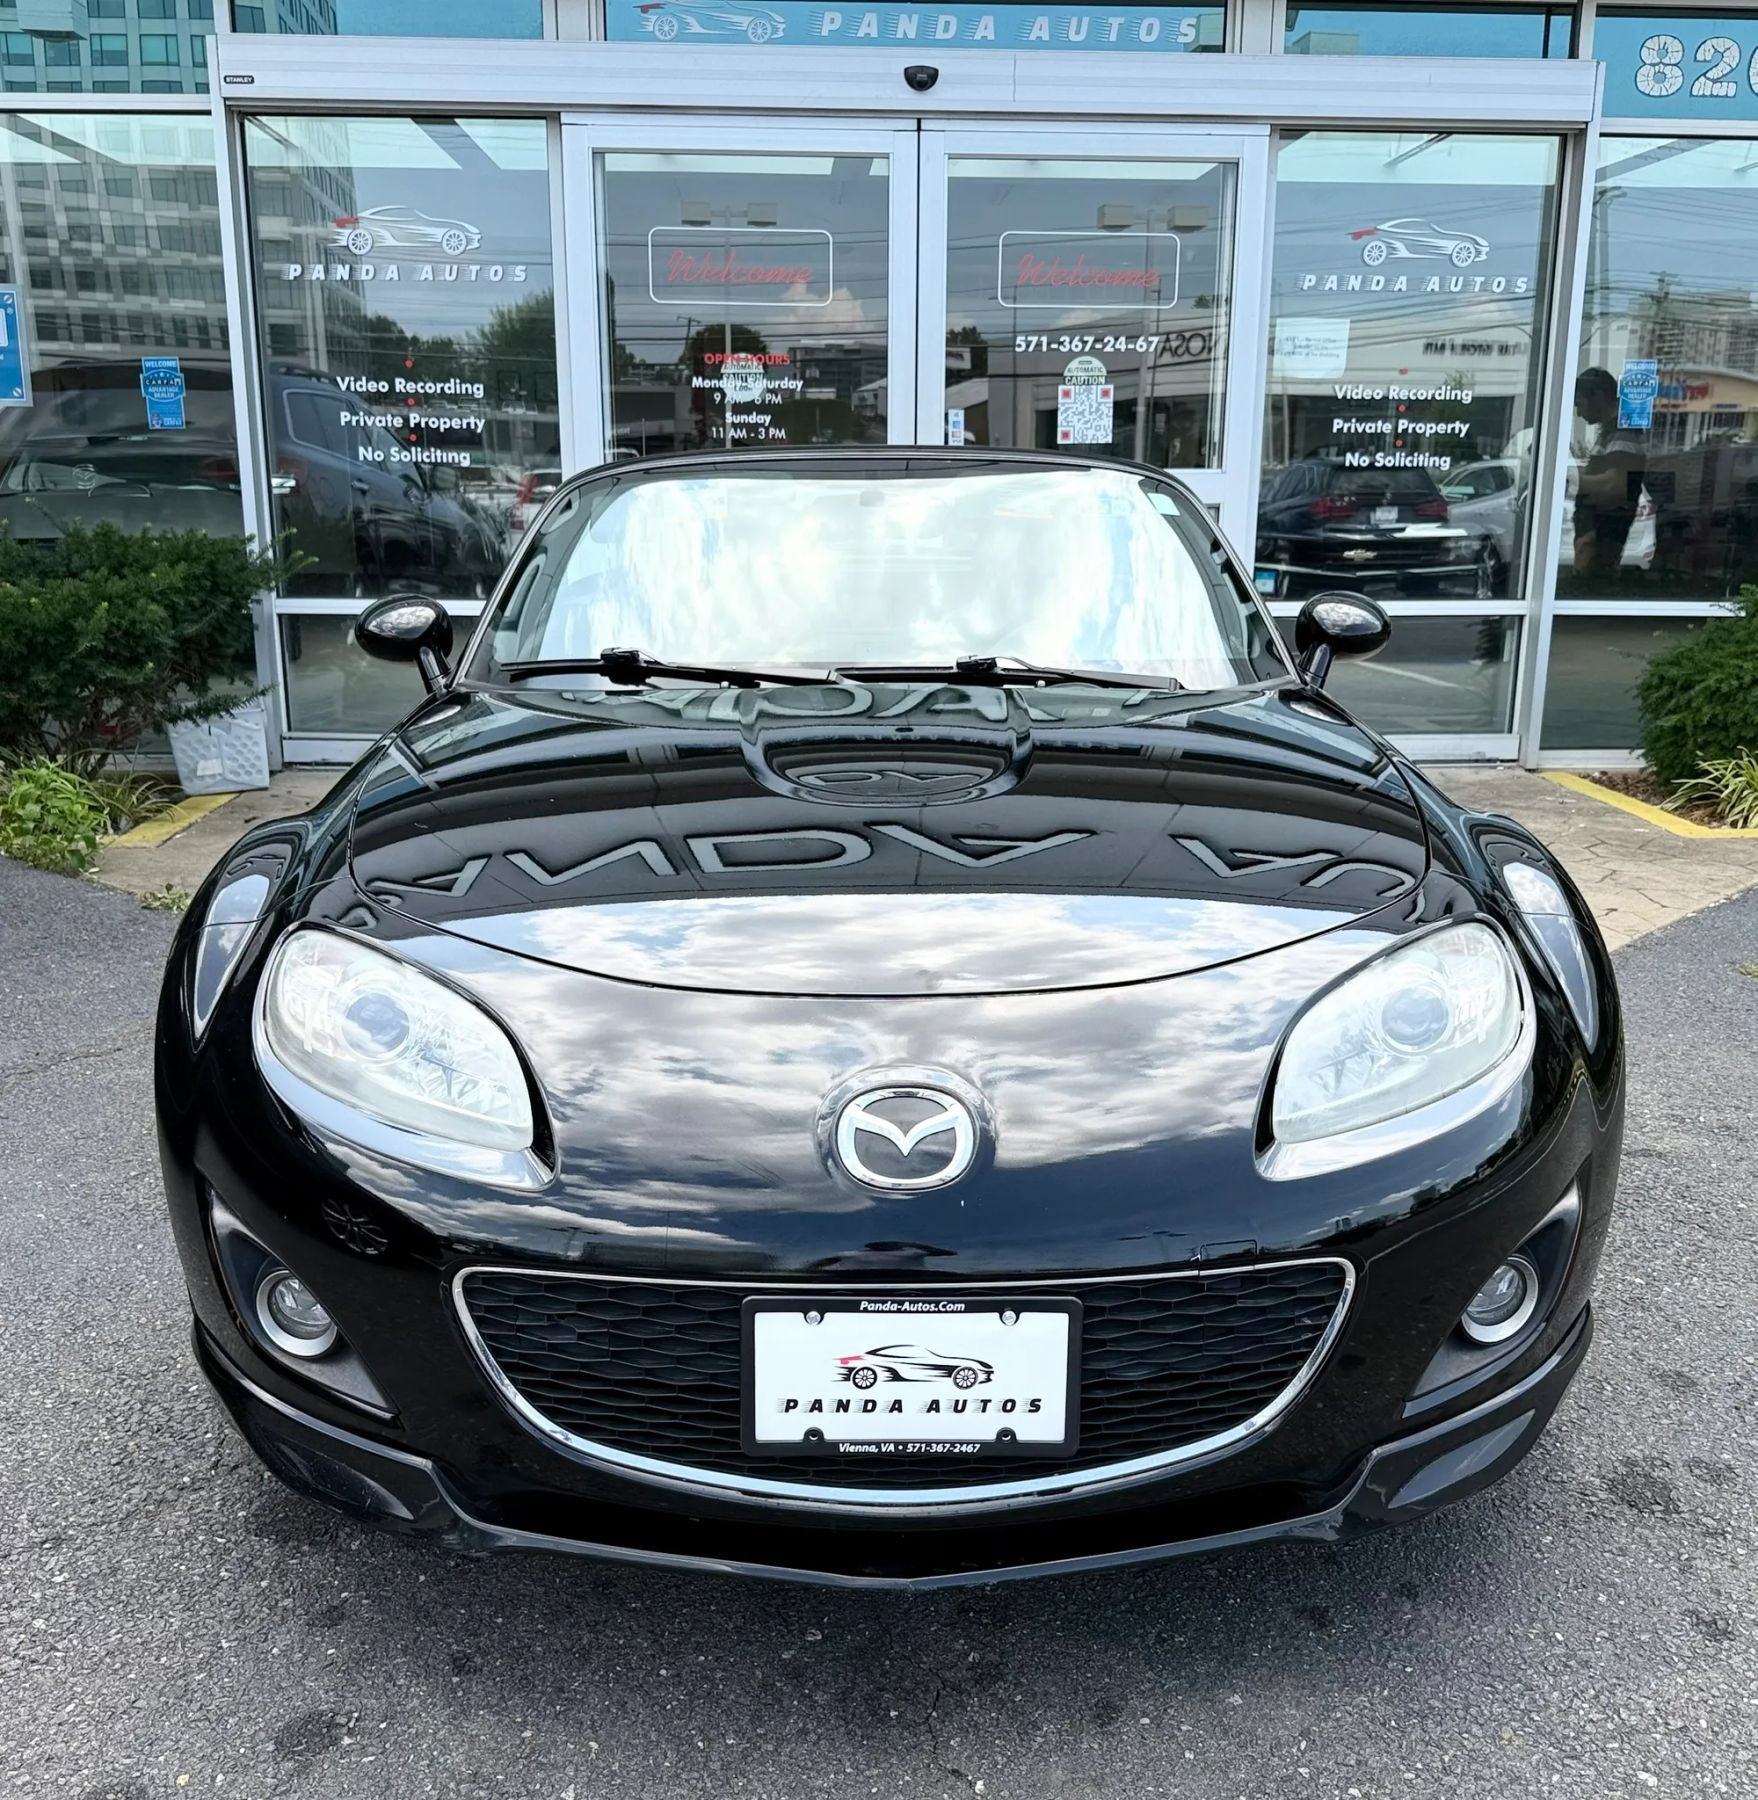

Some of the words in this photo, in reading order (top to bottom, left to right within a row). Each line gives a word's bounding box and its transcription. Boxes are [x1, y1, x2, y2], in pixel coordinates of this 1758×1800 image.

[818, 10, 995, 42] PANDA
[1027, 14, 1197, 43] AUTOS
[1635, 33, 1758, 98] 82
[287, 263, 400, 282] PANDA
[419, 263, 527, 283] AUTOS
[667, 246, 814, 285] Welcome
[1016, 252, 1160, 287] Welcome
[1302, 274, 1408, 292] PANDA
[1426, 276, 1528, 294] AUTOS
[1014, 335, 1160, 353] 571-367-24-67
[144, 360, 177, 368] WELCOME
[703, 352, 739, 365] OPEN
[746, 353, 791, 366] HOURS
[335, 376, 390, 393] Video
[394, 377, 485, 399] Recording
[1065, 376, 1106, 385] CAUTION
[713, 392, 721, 404] 9
[765, 393, 783, 404] PM
[1334, 384, 1384, 400] Video
[1388, 385, 1473, 404] Recording
[339, 411, 404, 428] Private
[409, 412, 486, 433] Property
[725, 411, 772, 427] Sunday
[1332, 418, 1393, 434] Private
[1397, 418, 1471, 438] Property
[712, 427, 724, 439] 11
[728, 428, 747, 439] AM
[758, 428, 766, 439] 3
[769, 428, 786, 439] PM
[358, 446, 385, 462] No
[389, 447, 471, 467] Soliciting
[1345, 452, 1370, 467] No
[1374, 452, 1451, 471] Soliciting
[859, 1300, 966, 1312] Panda-Autos.Com
[784, 1398, 903, 1414] PANDA
[925, 1398, 1042, 1414] AUTOS
[839, 1443, 879, 1454] Vienna,
[881, 1443, 895, 1453] VA
[906, 1443, 981, 1454] 571-367-2467
